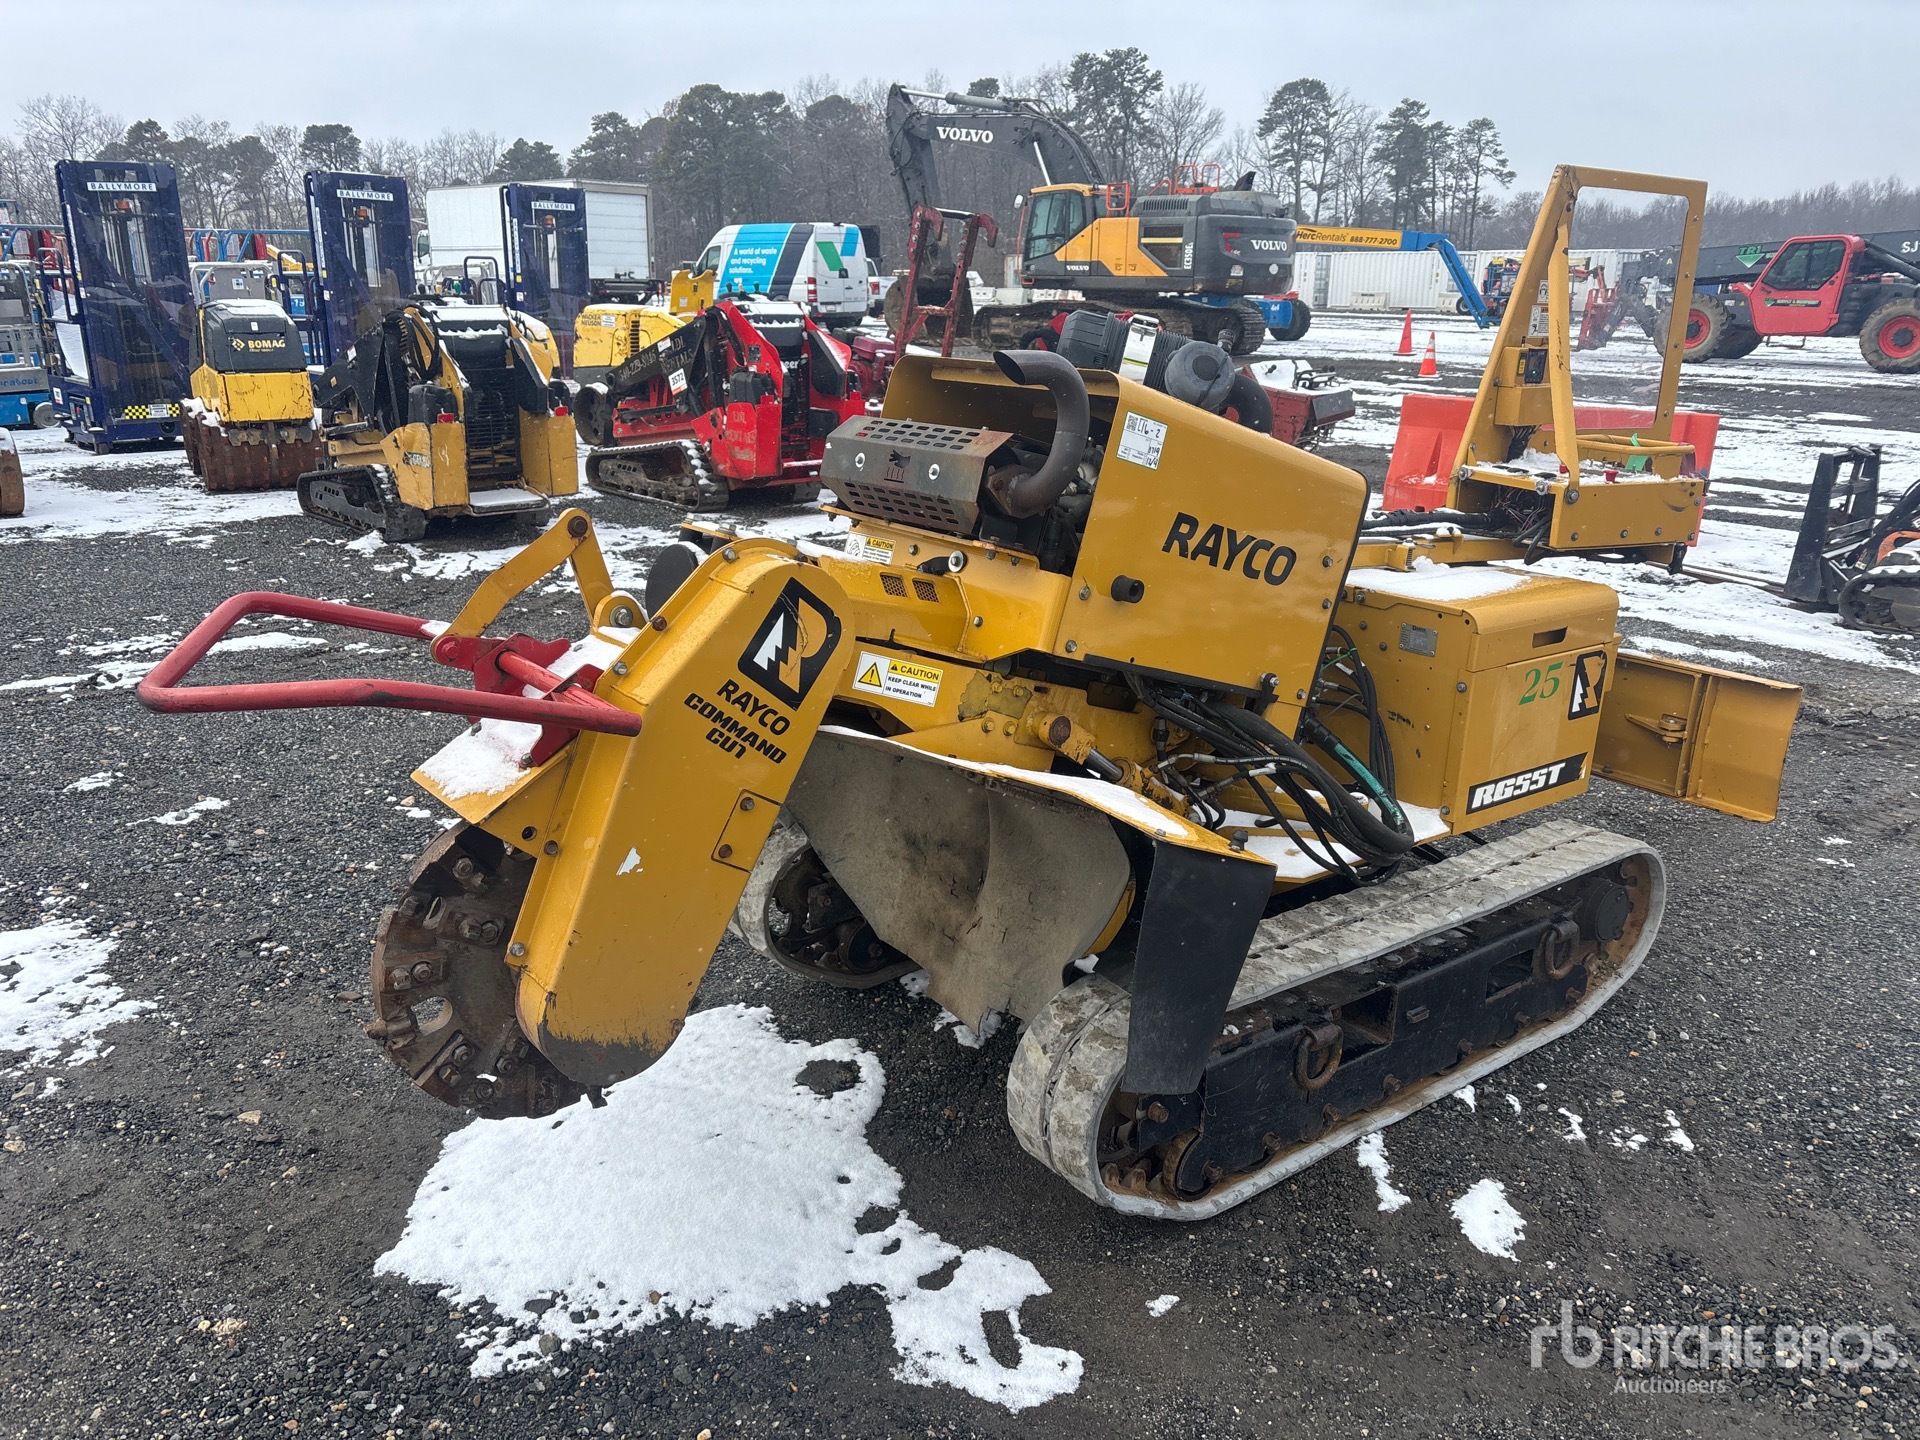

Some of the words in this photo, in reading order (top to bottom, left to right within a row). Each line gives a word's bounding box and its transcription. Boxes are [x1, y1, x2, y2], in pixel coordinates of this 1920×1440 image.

[935, 126, 994, 143] VOLVO
[90, 182, 154, 191] BALLYMORE
[339, 190, 391, 200] BALLYMORE
[1250, 239, 1288, 251] VOLVO
[1349, 235, 1398, 245] 888-777-2700
[739, 247, 754, 255] world
[754, 247, 761, 255] of
[761, 247, 777, 255] waste
[730, 257, 741, 265] and
[742, 257, 767, 266] recycling
[1066, 264, 1089, 272] VOLVO
[247, 339, 286, 349] BOMAG
[671, 372, 685, 387] 3572
[872, 539, 894, 549] CAUTION
[1161, 511, 1297, 586] RAYCO
[900, 665, 940, 681] CAUTION
[902, 678, 920, 687] CLEAR
[920, 683, 937, 692] WHILE
[1518, 661, 1564, 705] 25
[892, 687, 922, 698] OPERATION
[716, 678, 791, 736] RAYCO
[683, 692, 788, 764] COMMAND
[705, 727, 747, 759] CUT
